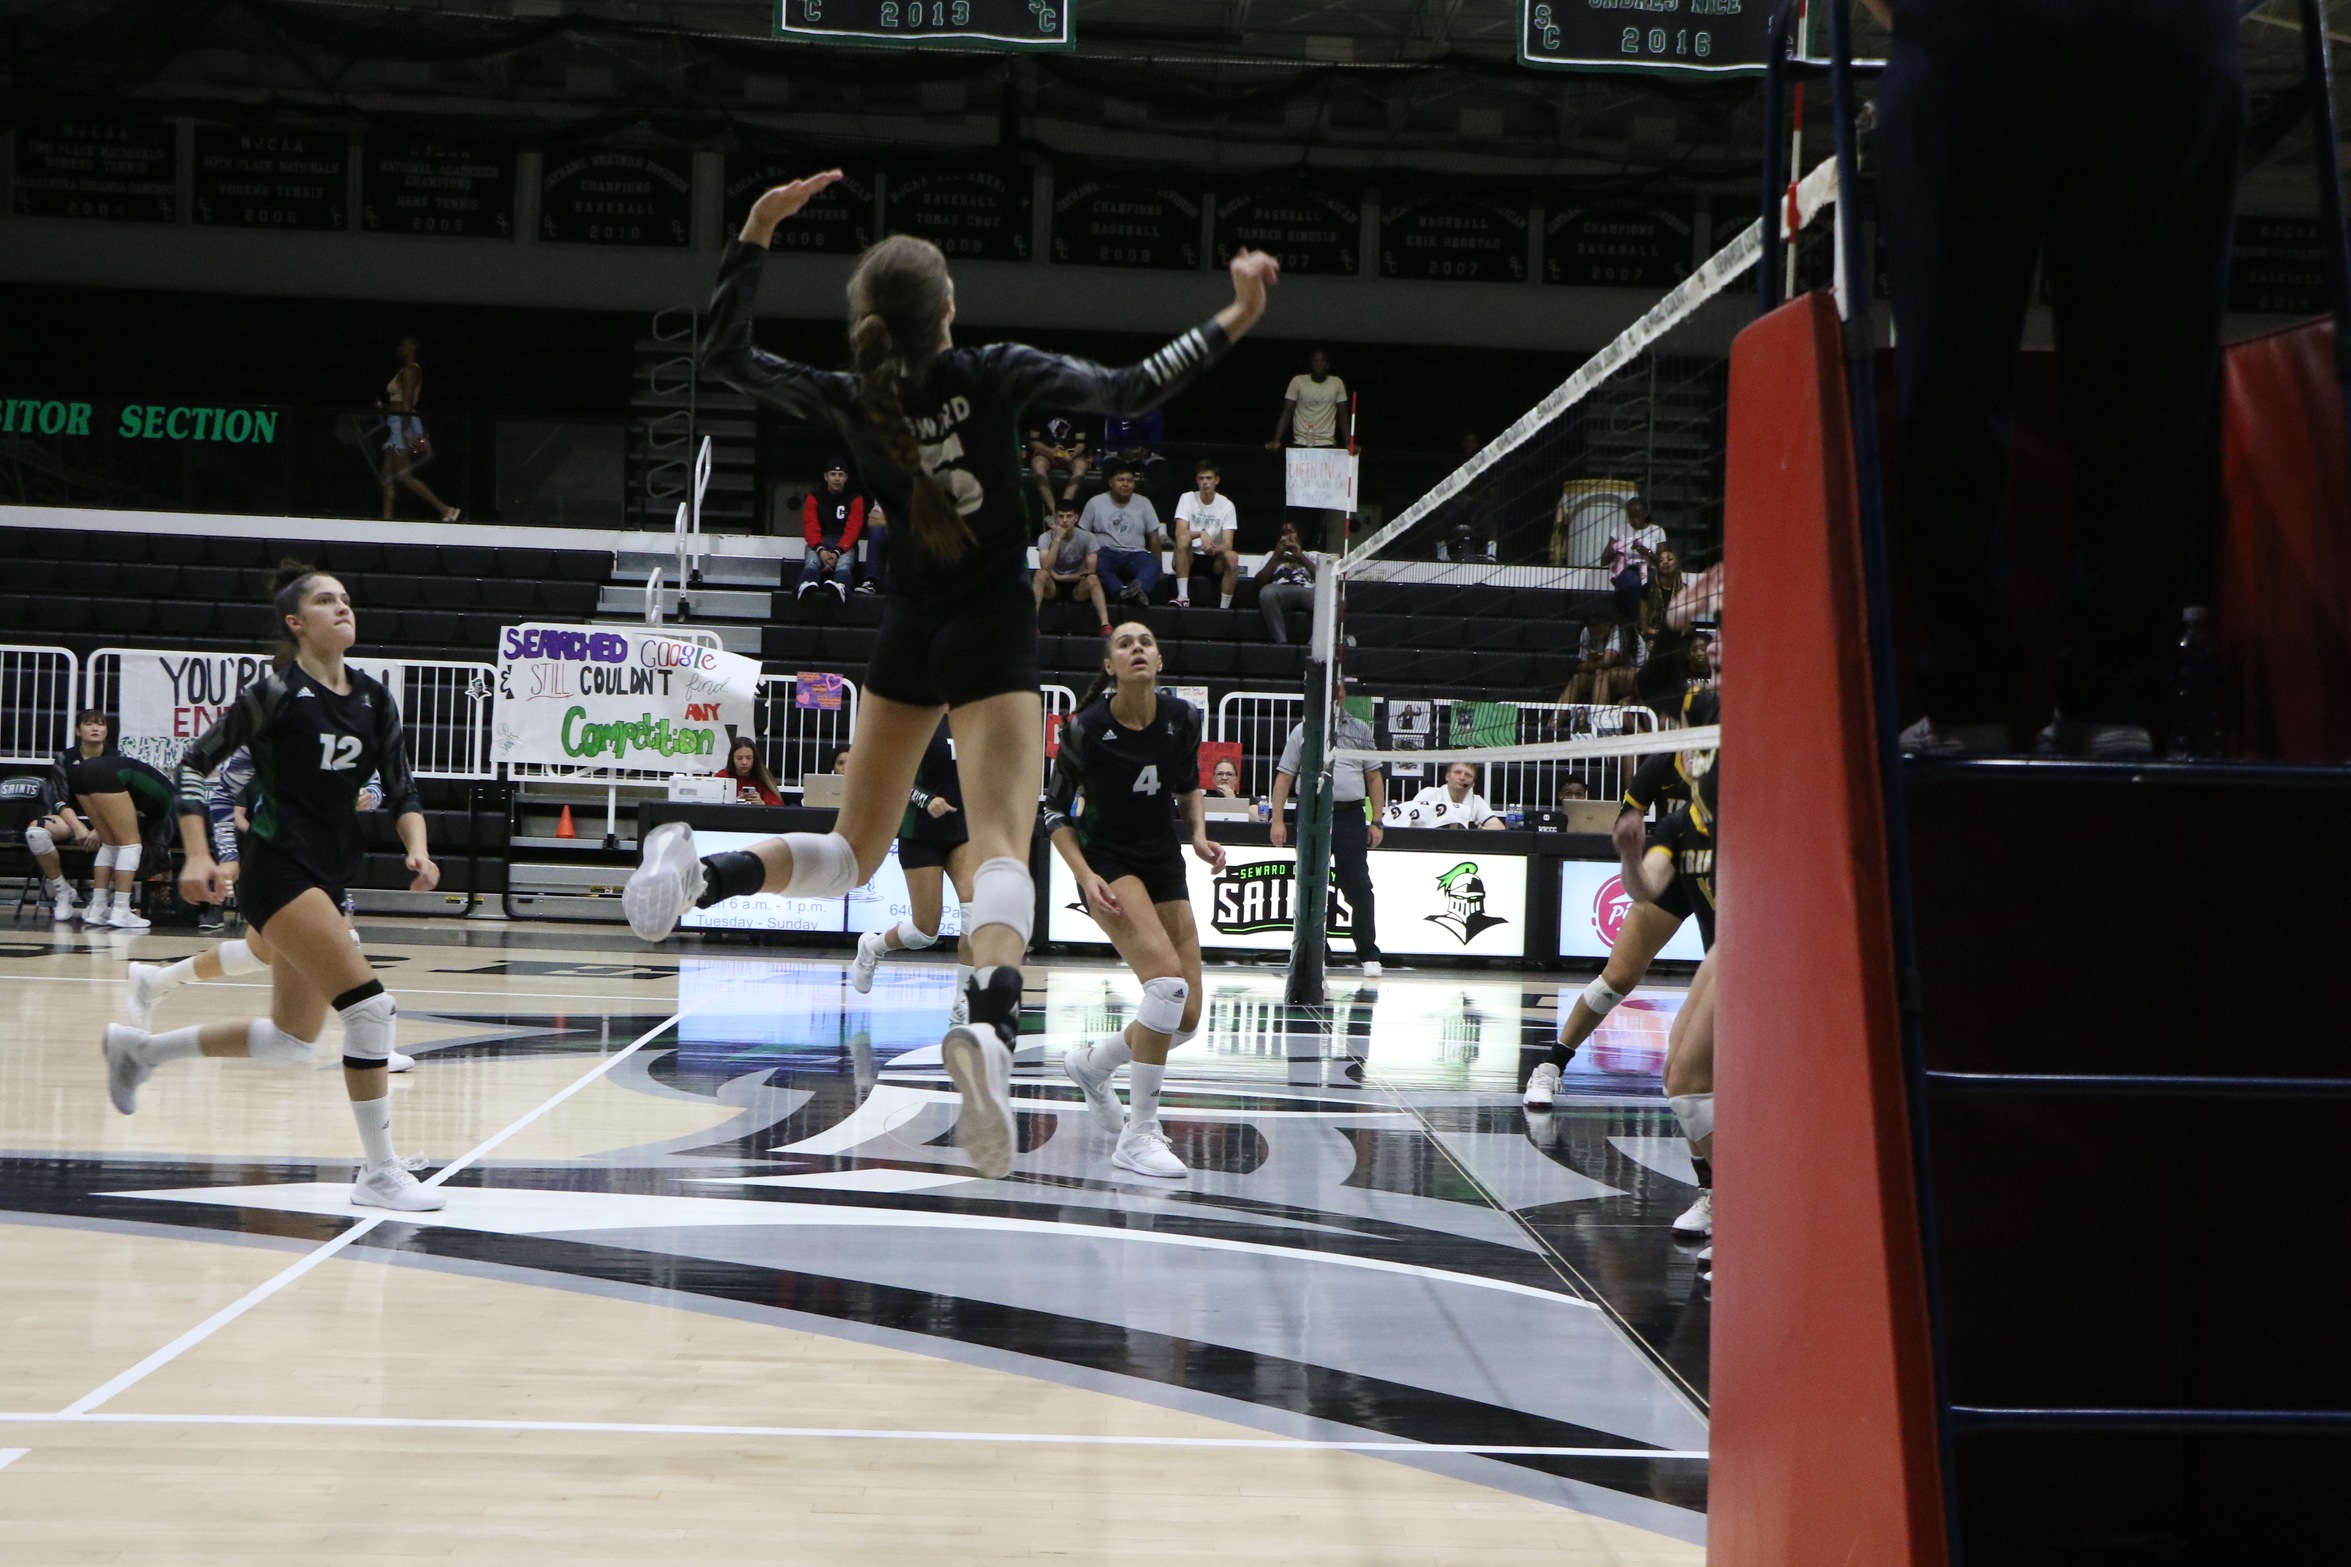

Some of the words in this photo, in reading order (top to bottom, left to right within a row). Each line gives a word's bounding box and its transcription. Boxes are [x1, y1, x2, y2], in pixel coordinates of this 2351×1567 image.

[880, 1, 970, 28] 2013
[1621, 27, 1712, 57] 2016
[580, 179, 651, 193] CHAMPIONS
[923, 193, 996, 207] BASEBALL
[574, 201, 655, 215] BASEBALL
[1093, 201, 1162, 216] CHAMPIONS
[1254, 208, 1321, 222] BASEBALL
[1092, 222, 1160, 237] BASEBALL
[1419, 215, 1488, 229] BASEBALL
[1584, 222, 1655, 235] CHAMPIONS
[590, 225, 641, 239] 2010
[1577, 242, 1660, 256] BASEBALL
[1429, 260, 1479, 275] 2007
[118, 404, 278, 443] SECTION
[504, 628, 628, 663] SEARCHED
[530, 663, 570, 695] STILL
[580, 666, 673, 695] COULDN'T
[685, 673, 730, 701] find
[685, 703, 721, 721] ANY
[561, 705, 715, 759] Competition
[319, 733, 363, 771] 12
[1132, 764, 1161, 796] 4
[2, 783, 38, 795] SAINTS
[1240, 864, 1286, 880] SEWARD
[729, 898, 738, 910] 6
[742, 900, 771, 911] a.m.
[798, 902, 827, 914] p.m.
[697, 914, 753, 928] Tuesday
[767, 917, 818, 930] Sunday
